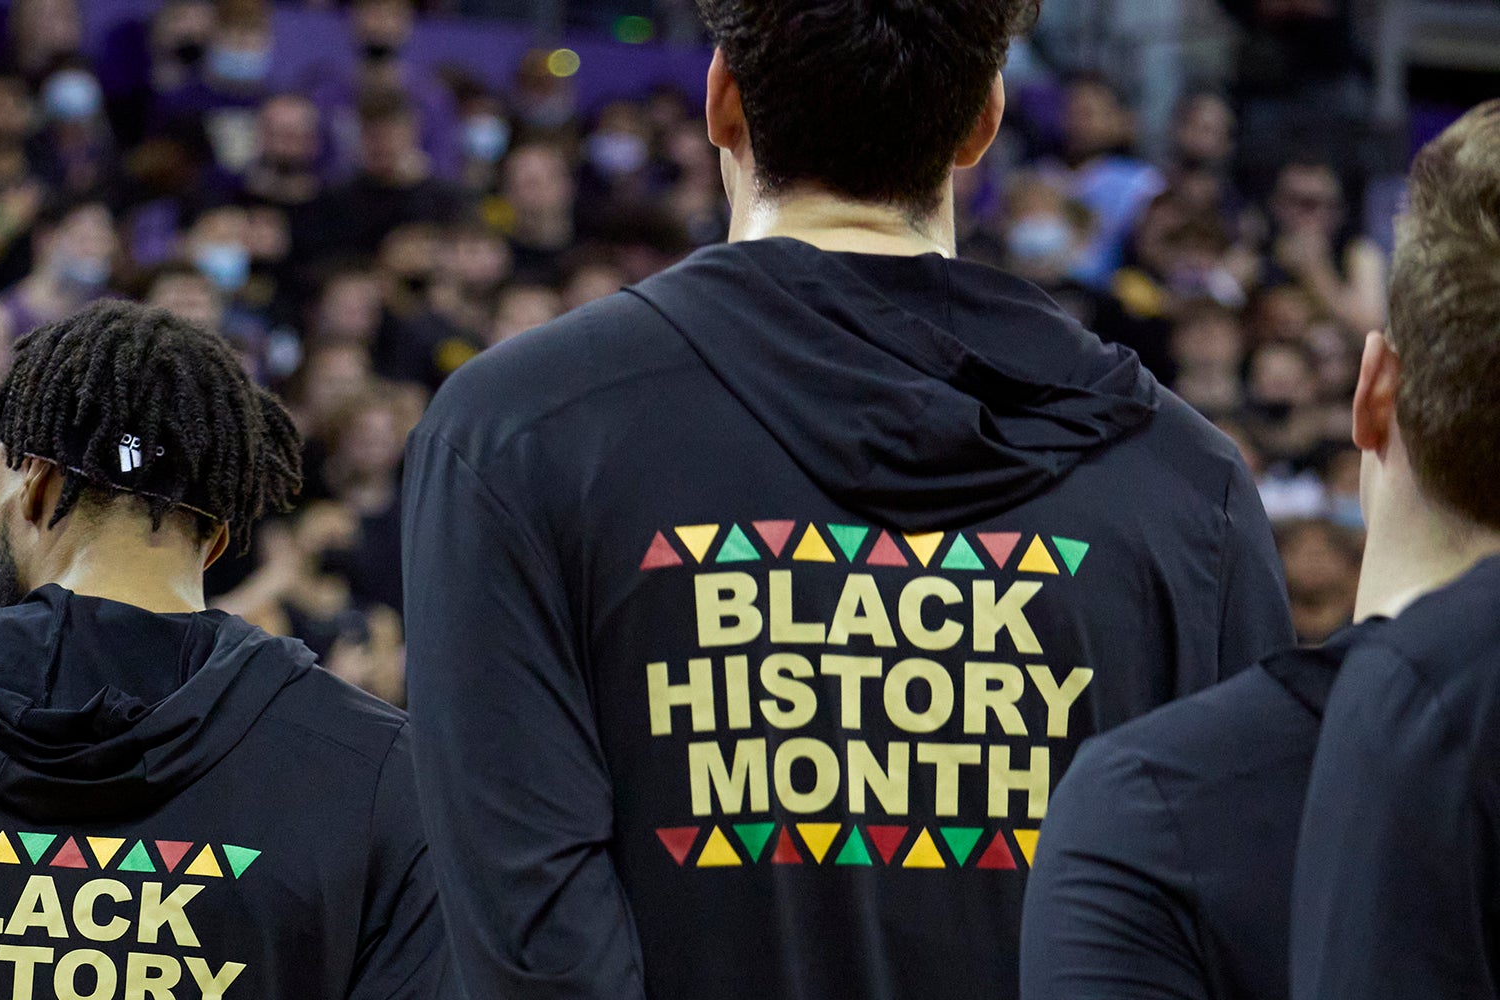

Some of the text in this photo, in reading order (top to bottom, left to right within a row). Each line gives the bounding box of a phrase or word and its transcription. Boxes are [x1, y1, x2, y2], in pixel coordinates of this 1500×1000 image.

[693, 569, 1044, 655] BLACK
[646, 652, 1094, 738] HISTORY
[688, 737, 1051, 820] MONTH
